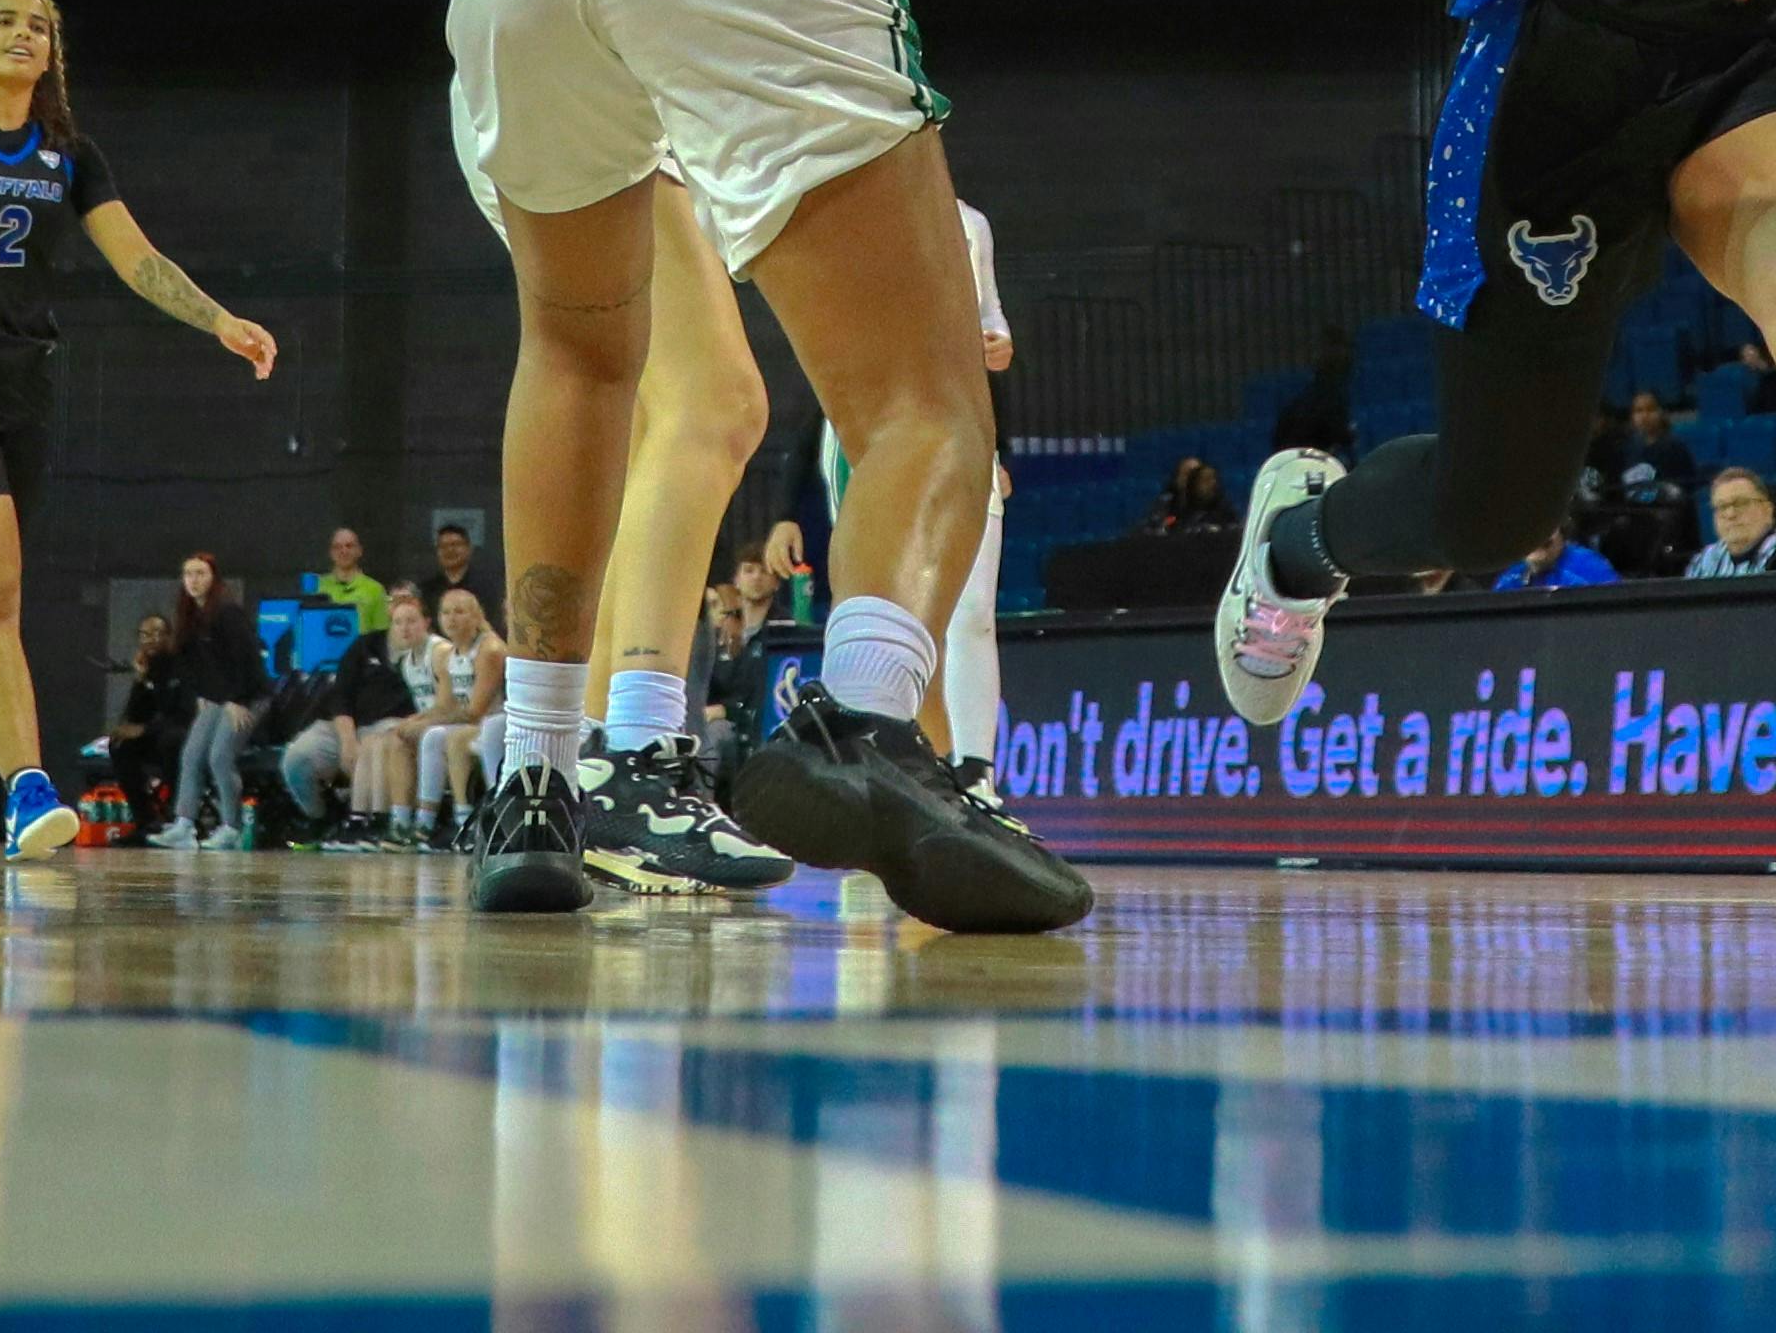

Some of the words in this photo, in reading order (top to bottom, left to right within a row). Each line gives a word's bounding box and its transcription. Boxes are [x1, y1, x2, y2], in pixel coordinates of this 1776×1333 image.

[1113, 680, 1262, 798] drive.
[1279, 681, 1380, 797] Get
[1393, 711, 1430, 797] a
[1445, 667, 1588, 797] ride.
